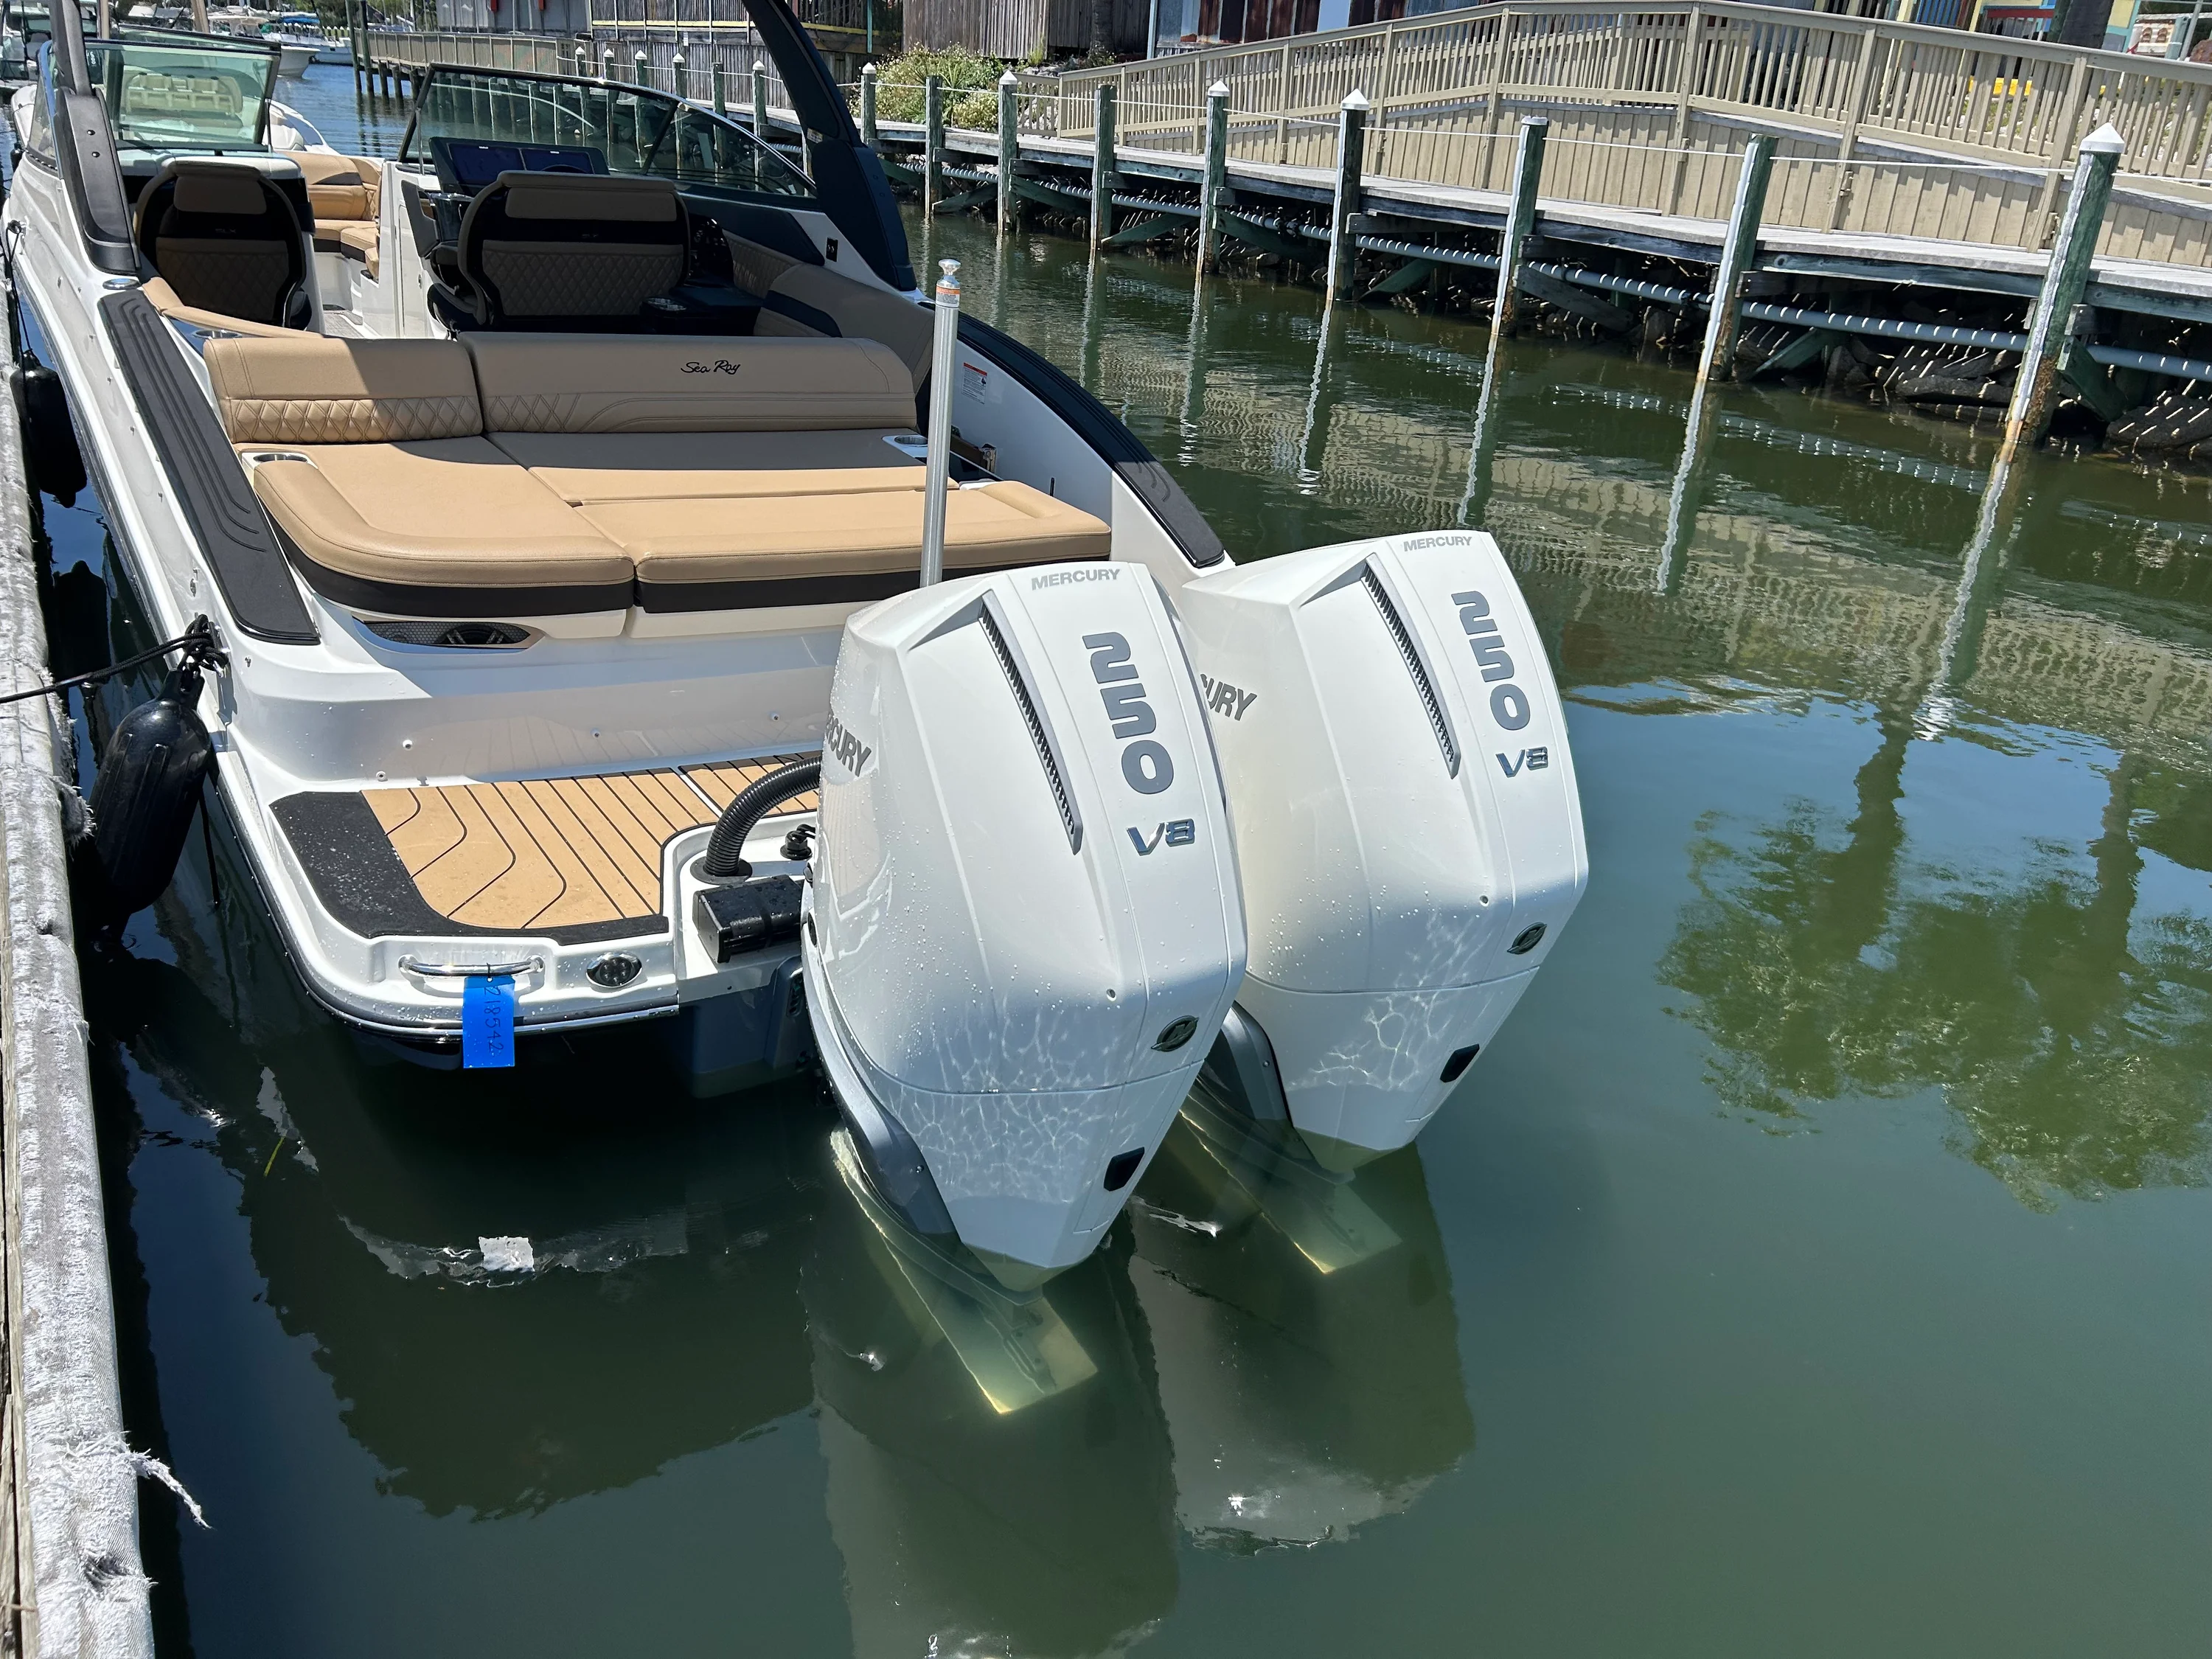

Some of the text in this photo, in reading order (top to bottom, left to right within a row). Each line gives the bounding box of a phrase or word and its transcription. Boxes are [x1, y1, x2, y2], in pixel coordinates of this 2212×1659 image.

[680, 360, 741, 375] Sea Ray
[1403, 536, 1472, 552] MERCURY
[1032, 568, 1121, 591] MERCURY
[1450, 591, 1531, 731] 250
[1082, 631, 1174, 795] 250
[1495, 746, 1548, 778] V8
[1125, 818, 1195, 856] V8
[484, 985, 504, 1053] 218542
